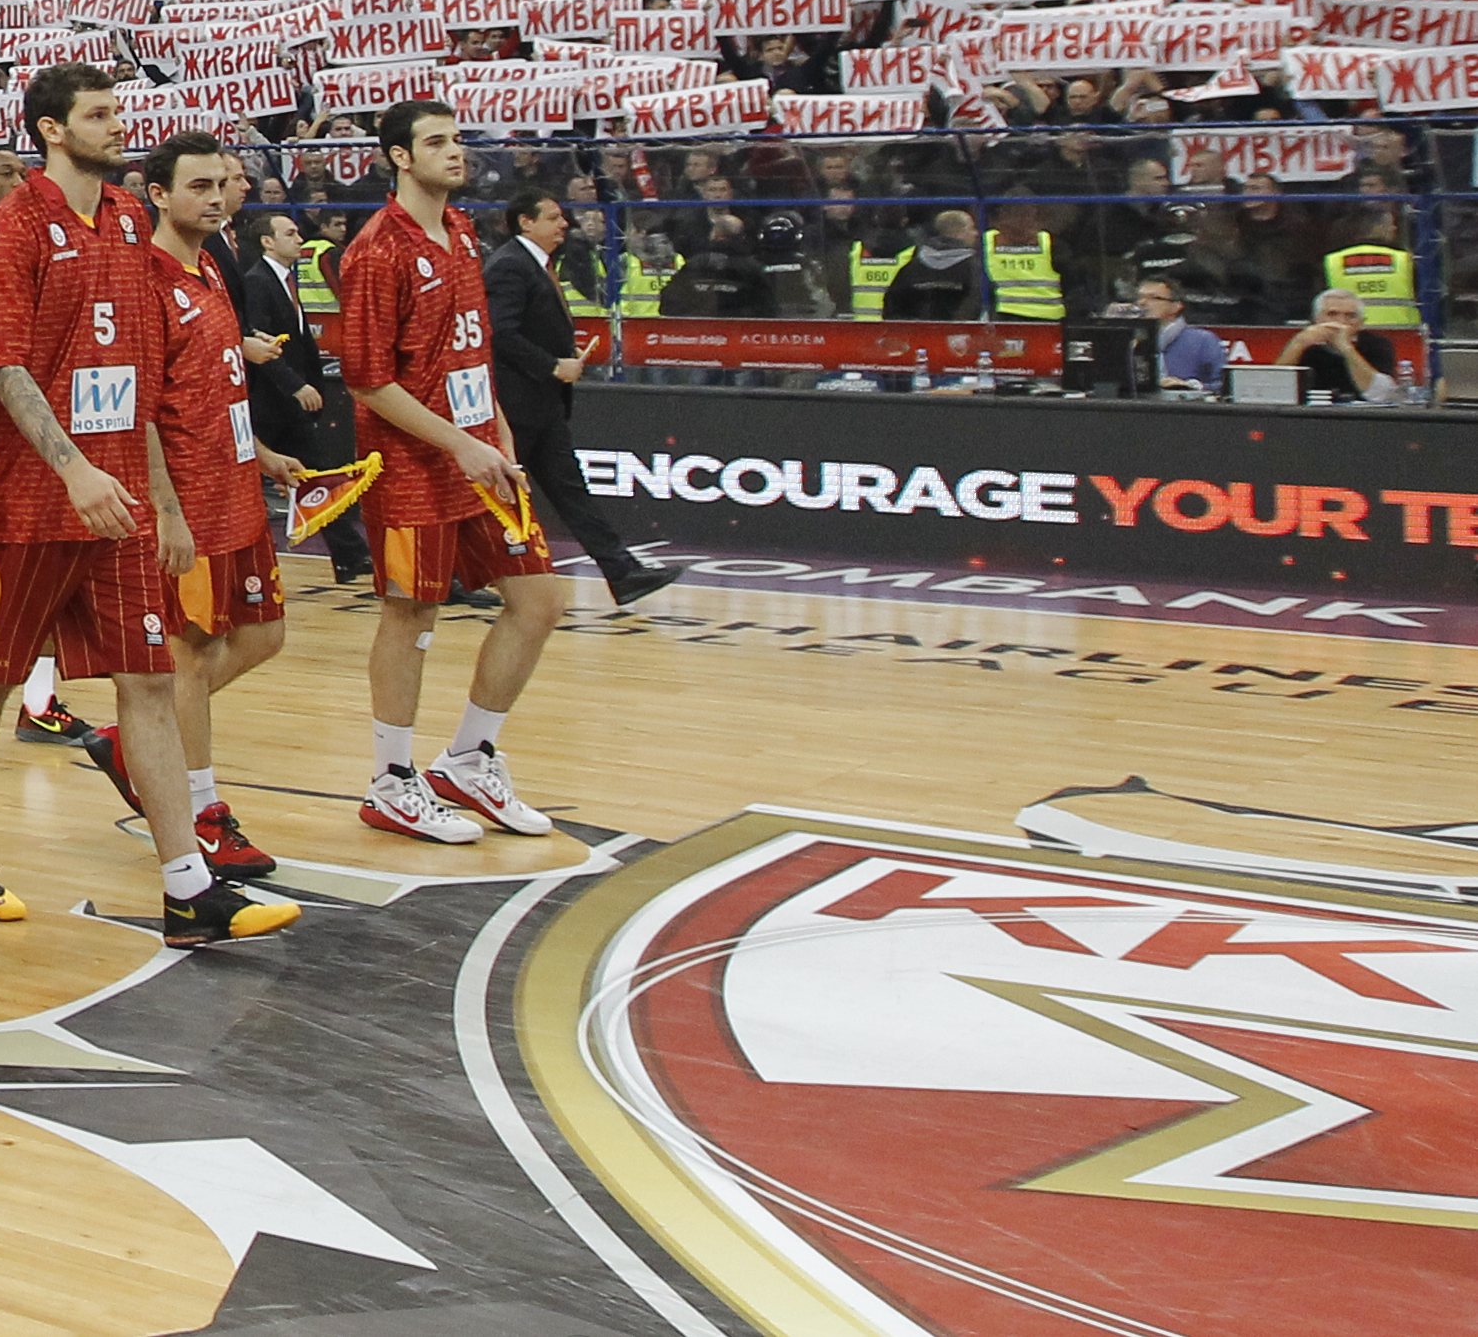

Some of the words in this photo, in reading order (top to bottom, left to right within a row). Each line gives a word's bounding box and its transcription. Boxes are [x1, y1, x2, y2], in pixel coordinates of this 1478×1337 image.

[330, 18, 443, 59] ЖИВИШ
[183, 41, 277, 80] ЖИВИШ
[180, 74, 292, 114] ЖИВИШ
[322, 67, 433, 104] ЖИВИШ
[456, 84, 570, 127] ЖИВИШ
[632, 83, 767, 134] ЖИВИШ
[778, 98, 922, 134] ЖИВИШ
[93, 302, 117, 346] 5
[451, 310, 484, 352] 35
[741, 334, 826, 345] ACIBADEM
[74, 370, 132, 414] liv
[73, 417, 132, 432] HOSPITAL
[577, 449, 1079, 523] ENCOURAGE
[1090, 474, 1369, 541] YOUR
